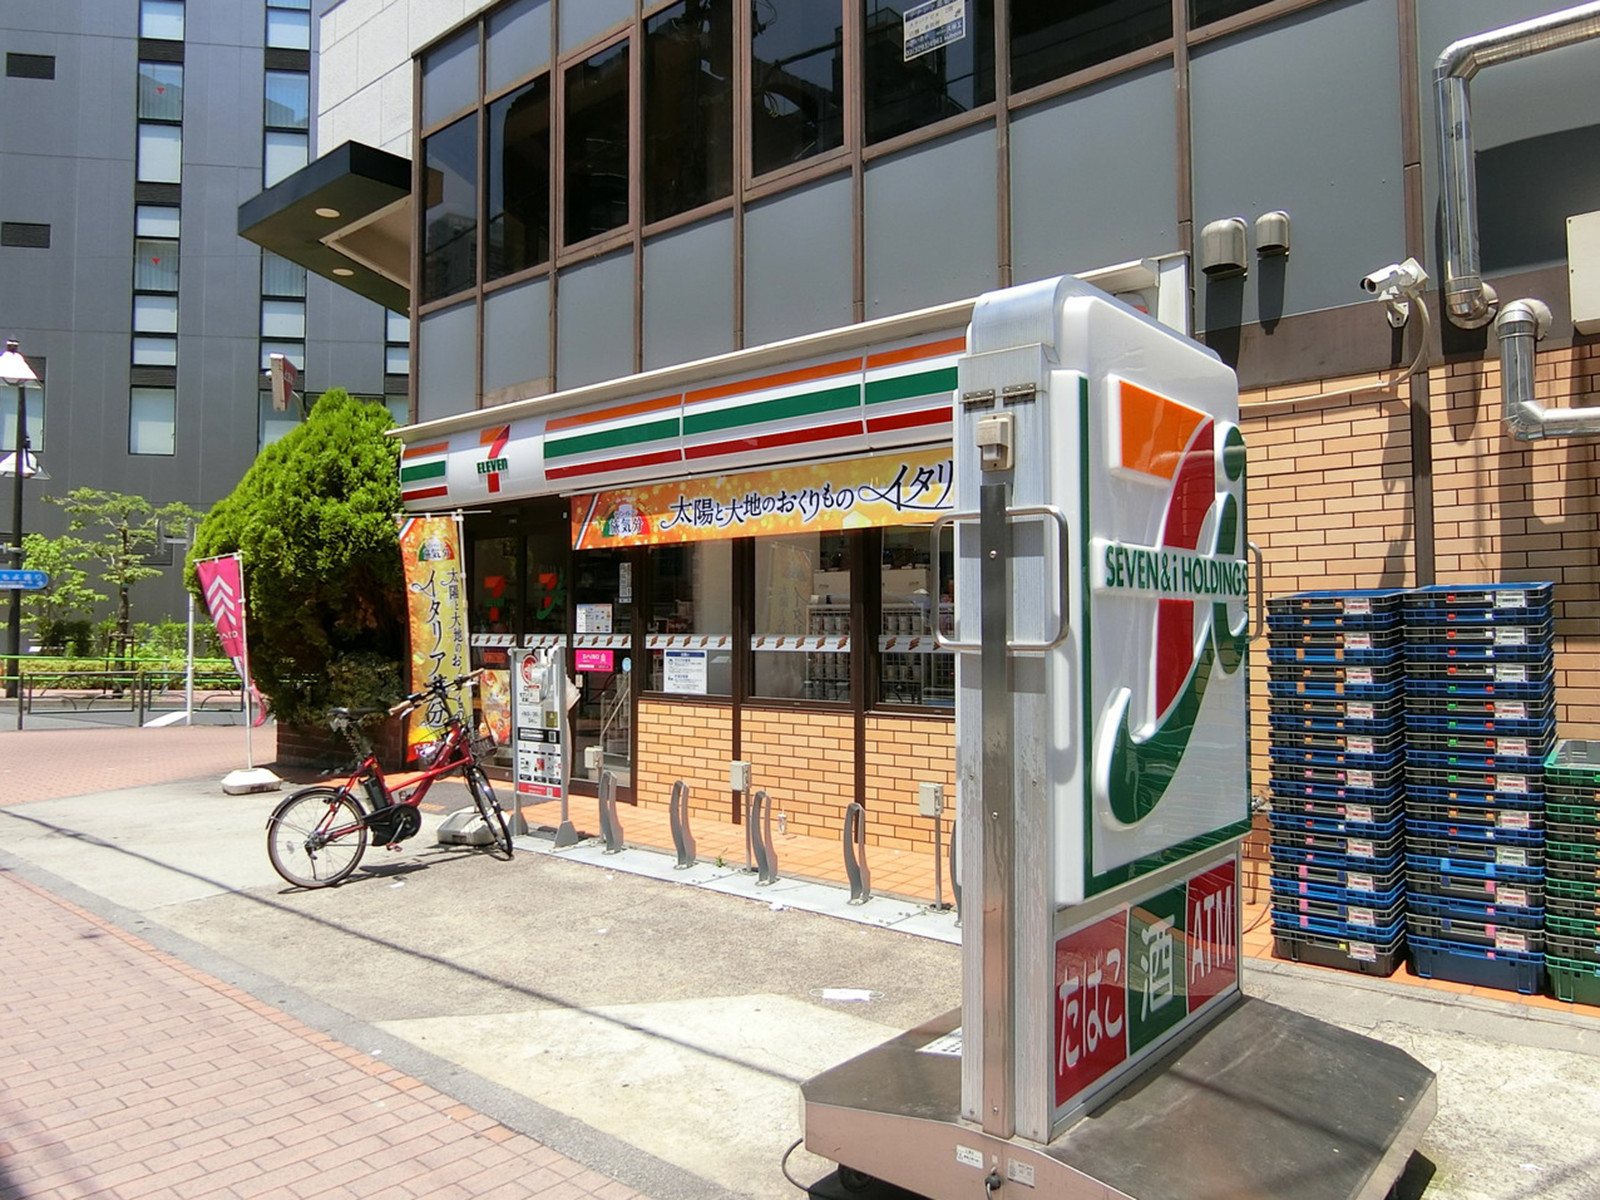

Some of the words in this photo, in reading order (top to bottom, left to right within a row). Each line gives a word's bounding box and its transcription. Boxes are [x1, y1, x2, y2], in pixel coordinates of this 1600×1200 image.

[659, 482, 855, 530] 太陽と大地のおくりもの
[1181, 553, 1248, 598] HOLDINGS
[1140, 914, 1176, 1023] 酒
[1190, 885, 1232, 985] ATM
[1058, 947, 1123, 1077] たばこ
